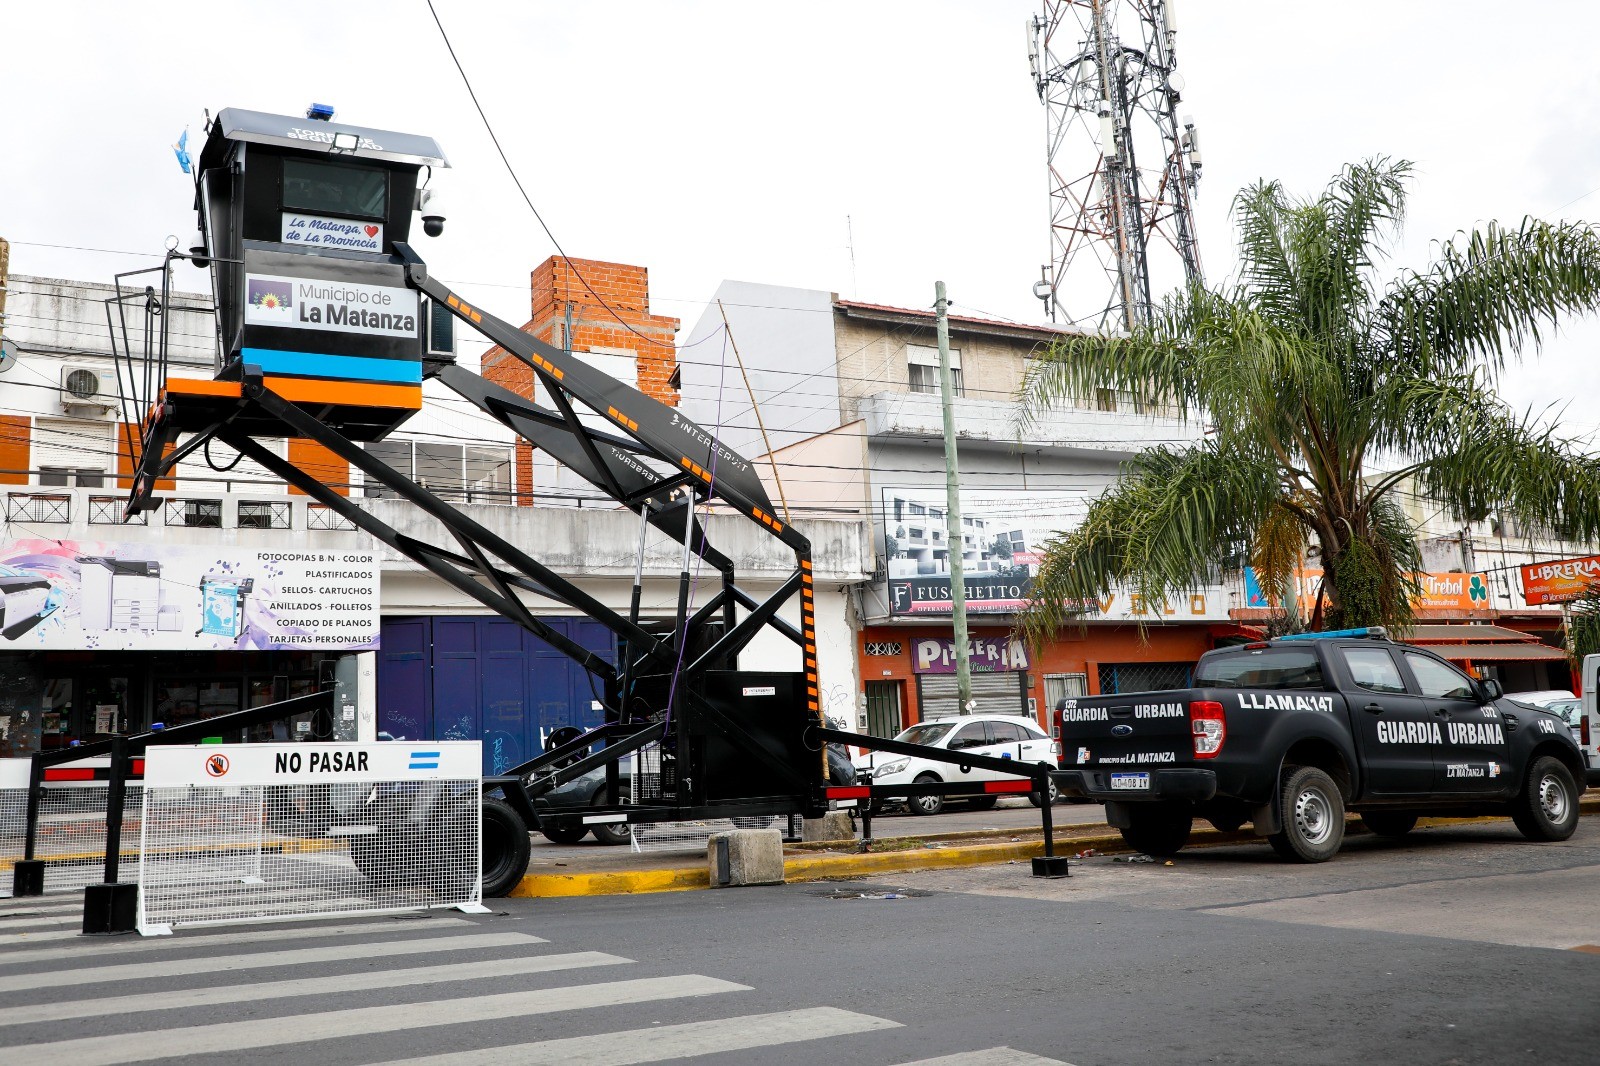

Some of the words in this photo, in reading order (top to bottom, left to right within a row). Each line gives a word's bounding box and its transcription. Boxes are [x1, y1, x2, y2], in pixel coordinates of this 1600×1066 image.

[287, 132, 384, 150] SEGUAD
[292, 128, 336, 138] TORR
[289, 218, 305, 228] La
[308, 220, 361, 235] Matanza,
[286, 230, 300, 240] de
[304, 232, 320, 242] La
[323, 234, 377, 248] Provincia
[300, 284, 369, 304] Municipio
[372, 291, 391, 306] de
[300, 302, 322, 323] La
[326, 304, 414, 332] Matanza
[257, 553, 316, 562] FOTOCOPIAS
[343, 555, 373, 563] COLOR
[306, 571, 373, 579] PLASTIFICADOS
[918, 586, 1020, 600] FUSHETTO
[1427, 576, 1463, 595] Trebol
[277, 619, 319, 627] COPIADO
[1062, 707, 1109, 722] GUARDIA
[1134, 703, 1184, 719] URBANA
[1480, 706, 1497, 718] 1372
[1377, 721, 1442, 744] GUARDIA
[1448, 722, 1504, 745] URBANA
[276, 752, 301, 773] NO
[310, 751, 368, 772] PASAR
[1126, 753, 1136, 763] LA
[1137, 752, 1176, 763] MATANZA
[1447, 768, 1455, 778] LA
[1456, 768, 1484, 778] MATANZA
